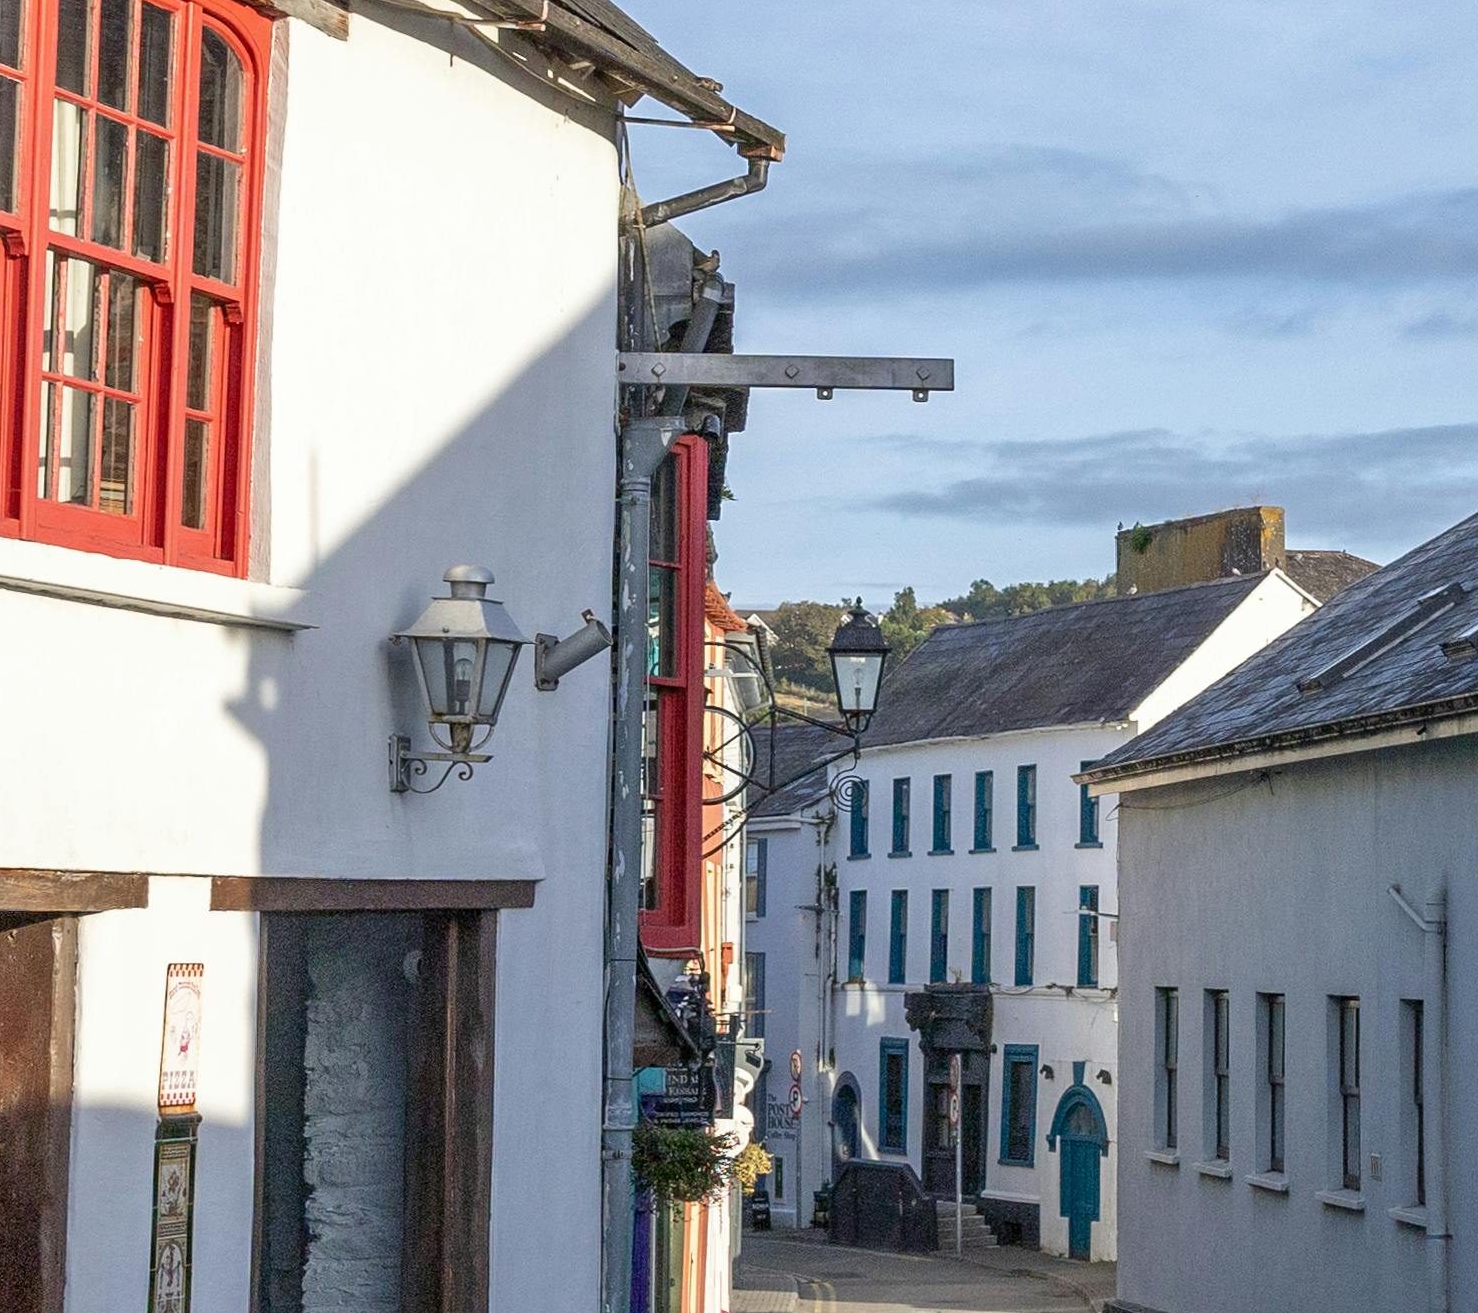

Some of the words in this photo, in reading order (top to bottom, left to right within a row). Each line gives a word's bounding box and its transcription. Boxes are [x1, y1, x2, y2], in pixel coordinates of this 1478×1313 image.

[162, 1070, 196, 1090] PIZZA
[768, 1103, 791, 1116] POST
[768, 1116, 797, 1129] HOUSE
